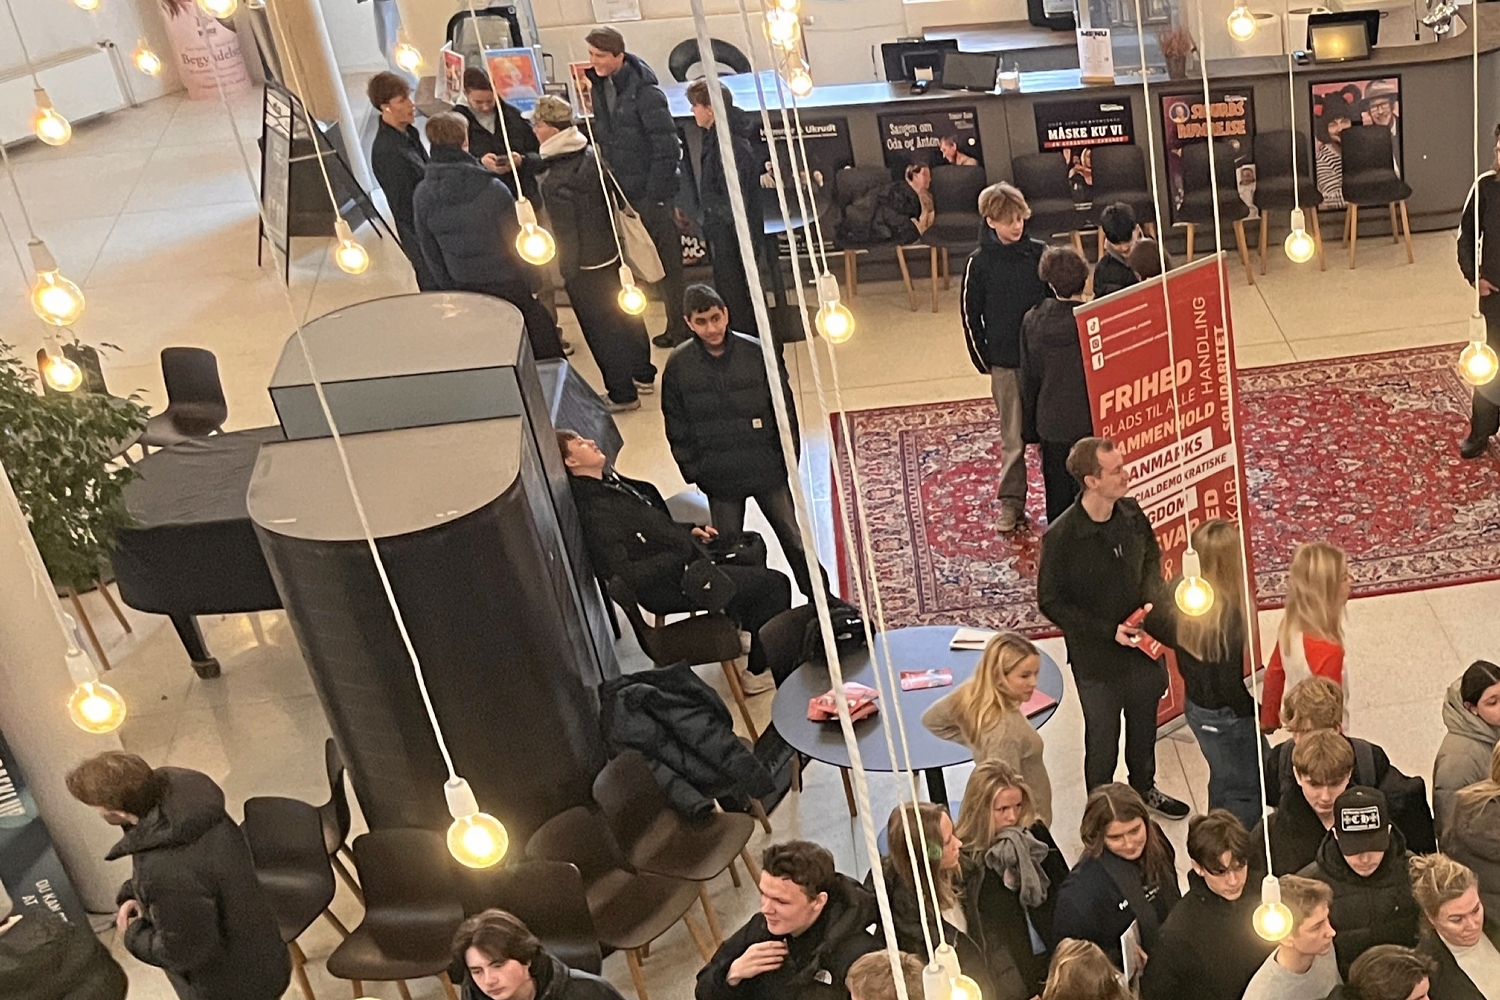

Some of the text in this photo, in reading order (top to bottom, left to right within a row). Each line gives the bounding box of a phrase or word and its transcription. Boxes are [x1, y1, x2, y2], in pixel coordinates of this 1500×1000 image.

[887, 137, 903, 150] Oda
[904, 138, 915, 151] og
[889, 123, 933, 136] Sangen om
[1048, 126, 1088, 140] MÅSKE
[1110, 124, 1123, 136] VI
[1193, 296, 1213, 395] HANDLING
[1100, 359, 1192, 420] FRIHED
[1102, 412, 1142, 439] PLADS
[1145, 403, 1163, 421] TIL
[1116, 401, 1215, 456] AMMENHOLD
[1128, 436, 1203, 482] ANMARKS
[1134, 452, 1227, 502] CIALDEMOKRATISKE
[22, 895, 38, 906] AT
[35, 879, 62, 913] DU KAN
